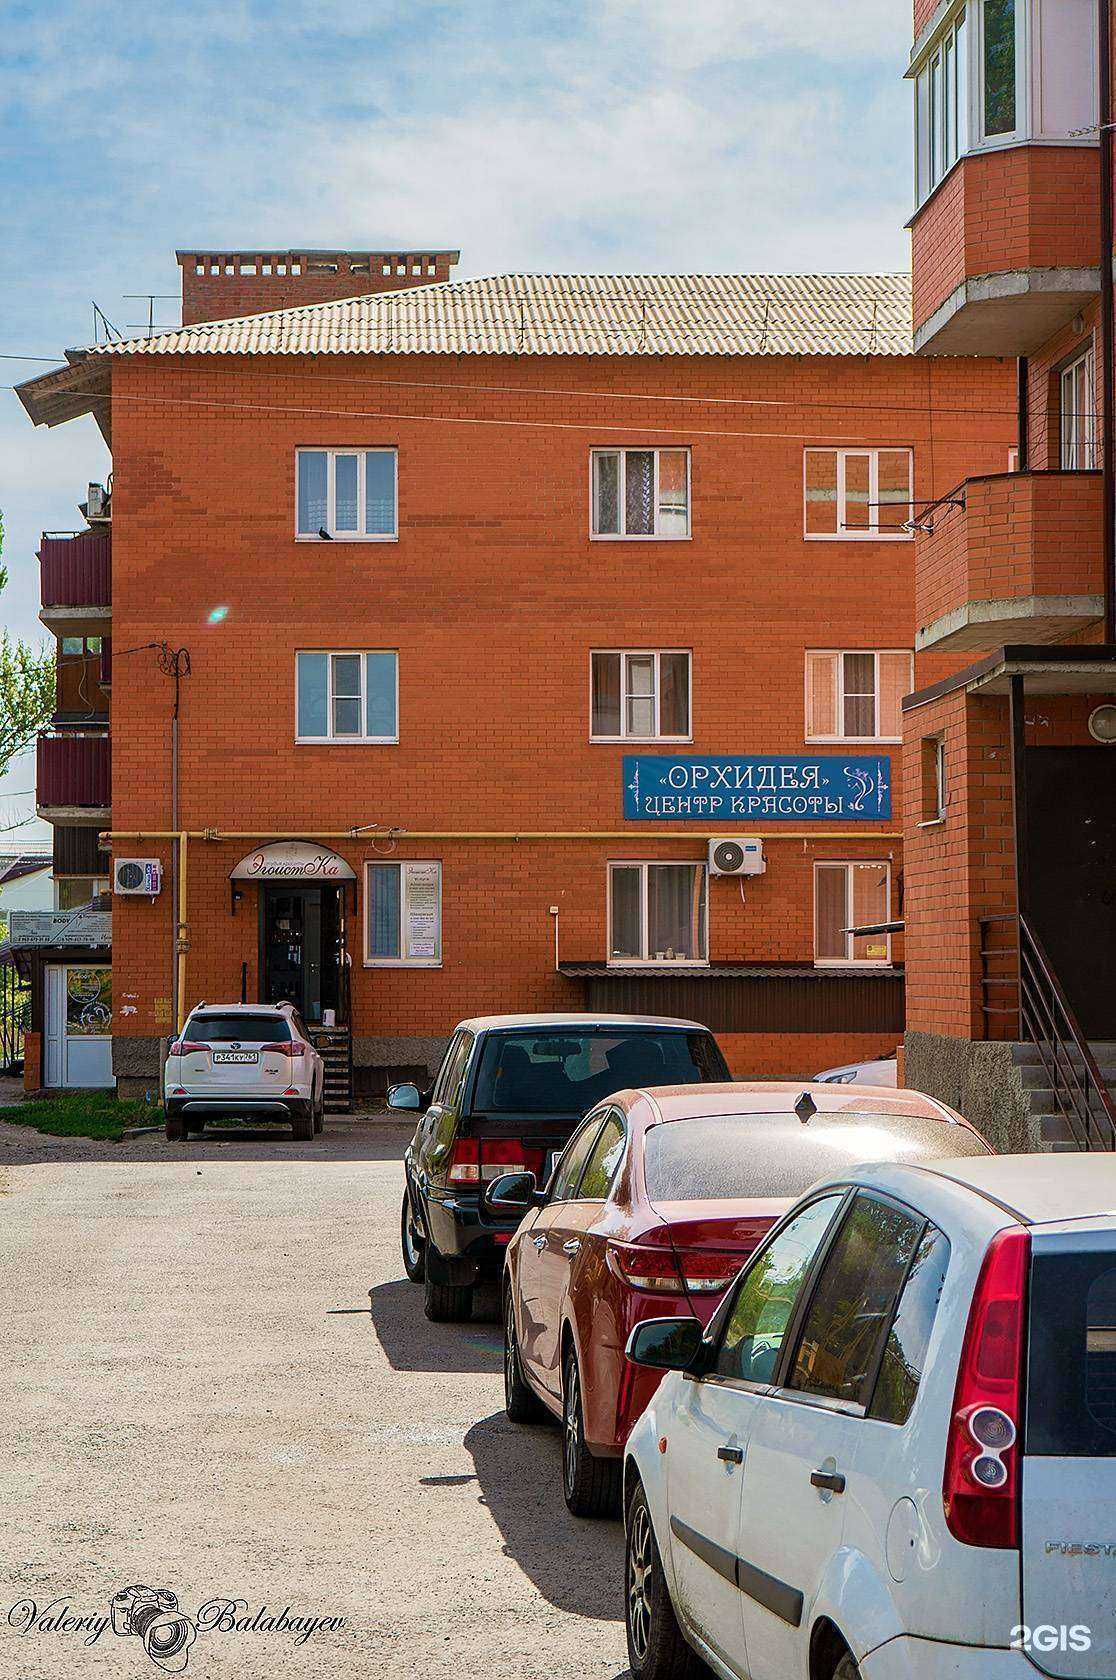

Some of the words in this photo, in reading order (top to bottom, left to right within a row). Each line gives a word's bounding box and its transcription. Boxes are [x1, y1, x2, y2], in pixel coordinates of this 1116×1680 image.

[659, 765, 830, 793] «ОРХИДЕЯ»
[645, 796, 723, 816] ЦЕНТР
[731, 796, 844, 814] КРАСОТЫ
[1045, 1541, 1116, 1556] FIEST
